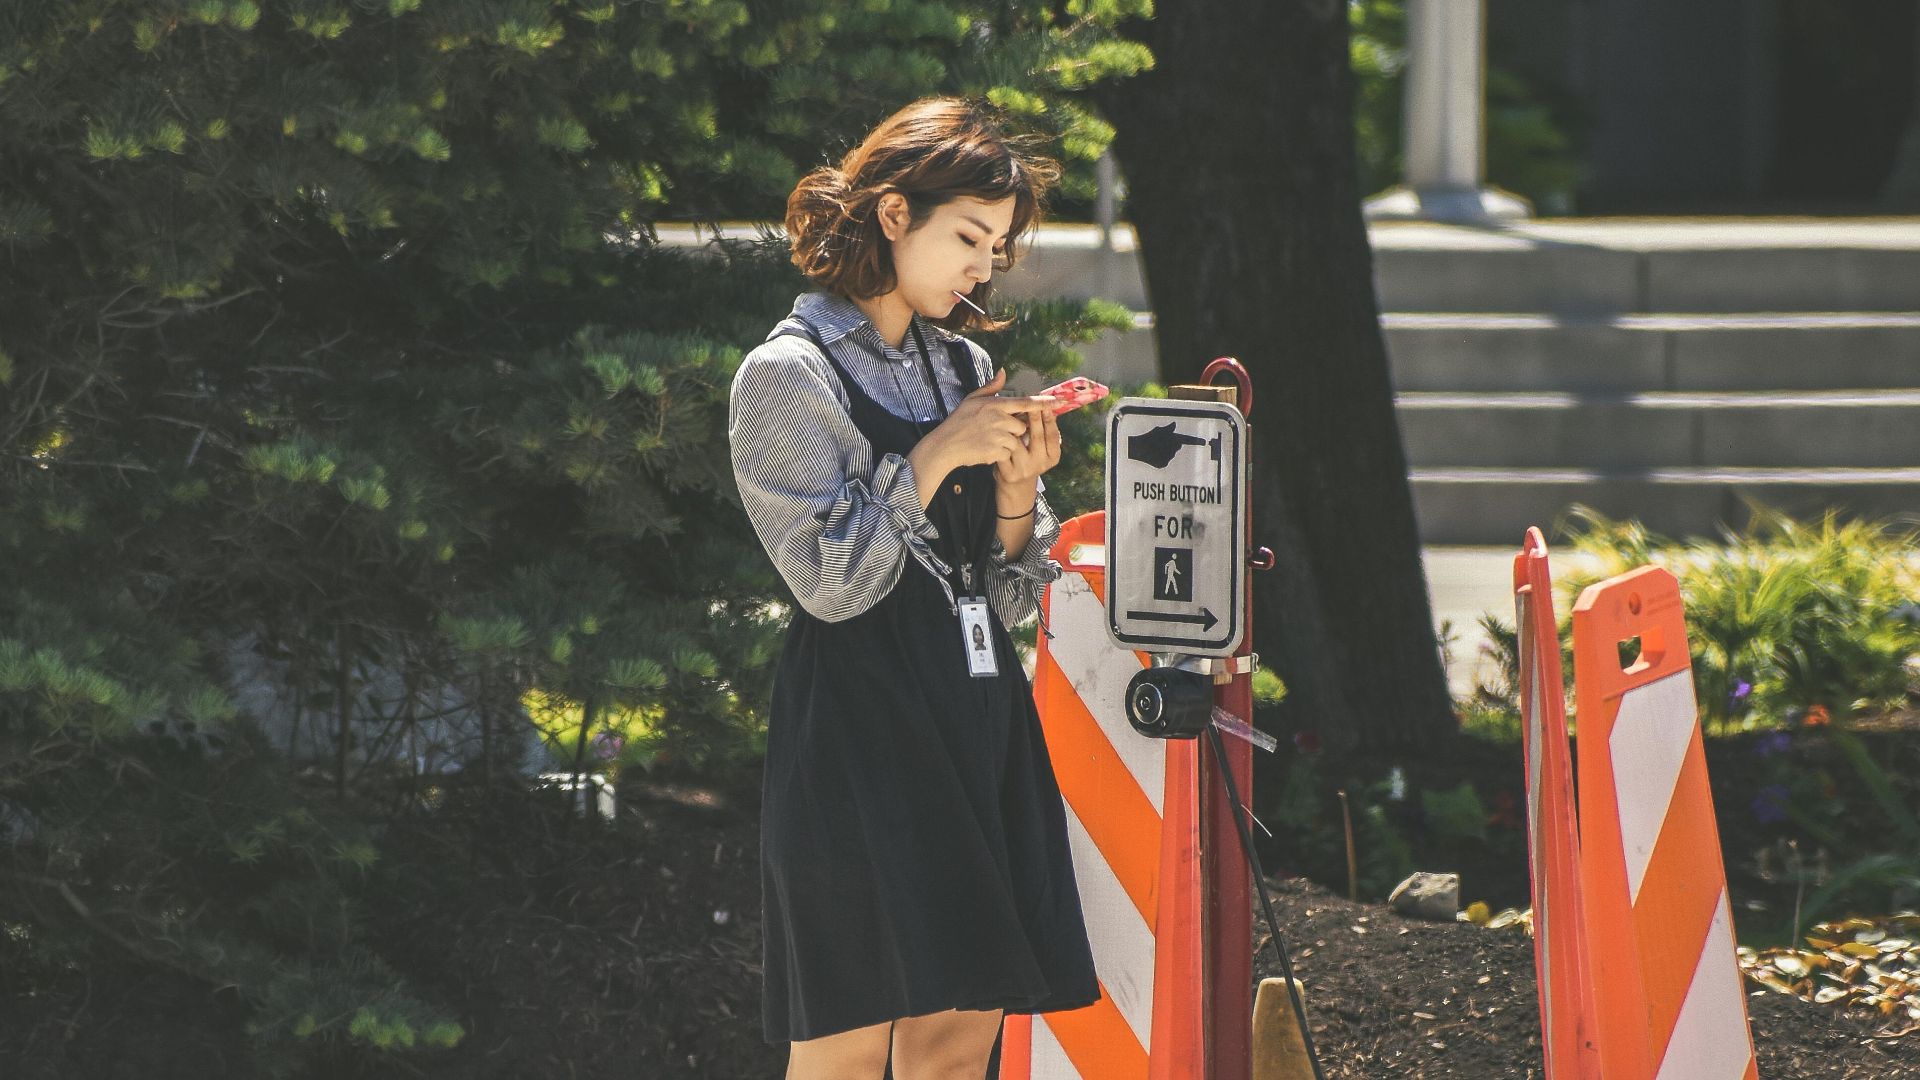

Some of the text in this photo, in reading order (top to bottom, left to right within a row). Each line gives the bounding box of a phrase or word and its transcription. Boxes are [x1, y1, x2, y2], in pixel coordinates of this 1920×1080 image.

[1133, 481, 1215, 504] PUSH BUTTON
[1154, 515, 1193, 540] FOR
